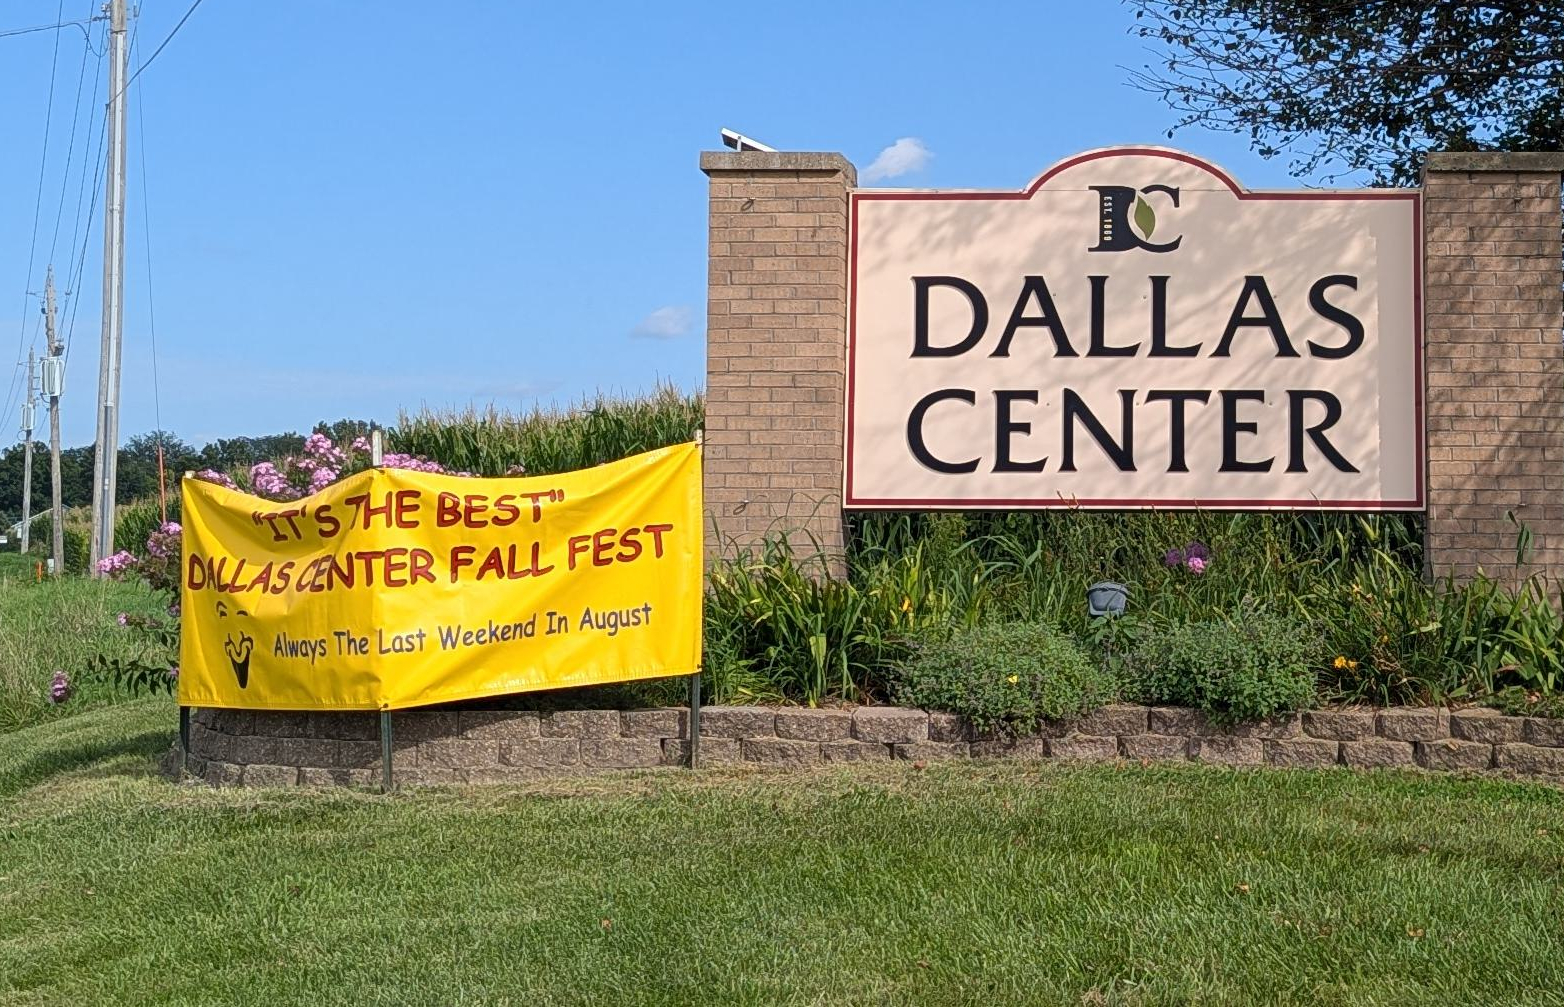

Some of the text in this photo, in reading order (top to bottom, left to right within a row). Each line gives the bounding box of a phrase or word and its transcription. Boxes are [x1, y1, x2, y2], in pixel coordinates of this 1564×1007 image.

[911, 275, 1365, 358] DALLAS
[907, 388, 1360, 474] CENTER
[252, 489, 565, 541] "IT'S THE BEST"
[188, 523, 674, 594] DALLAS CENTER FALL FEST
[274, 602, 652, 665] Always The Last Weekend In August
